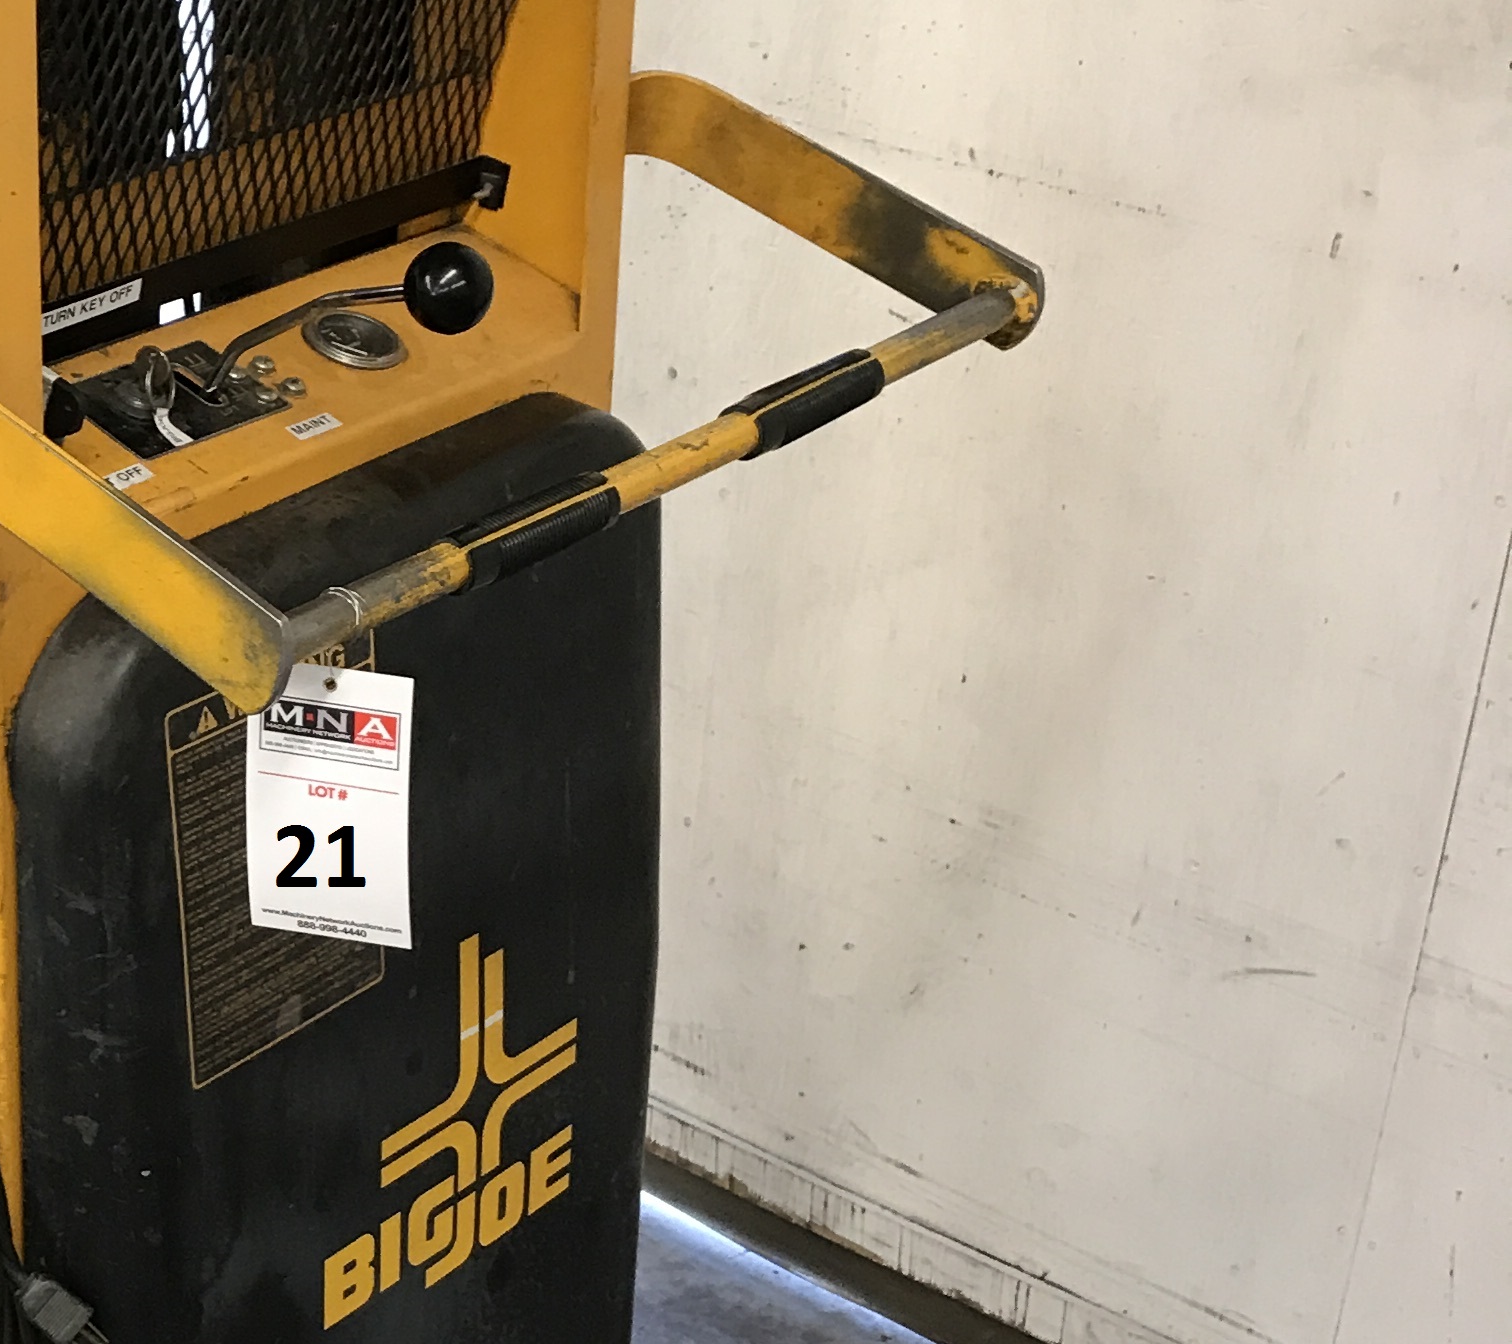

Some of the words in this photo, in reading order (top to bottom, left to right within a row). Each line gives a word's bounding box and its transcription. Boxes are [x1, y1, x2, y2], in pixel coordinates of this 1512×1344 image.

[43, 307, 76, 327] TURN
[80, 296, 105, 314] KEY
[110, 284, 134, 304] OFF
[290, 415, 332, 436] MAINT
[116, 466, 142, 482] OFF
[308, 784, 336, 799] LOT
